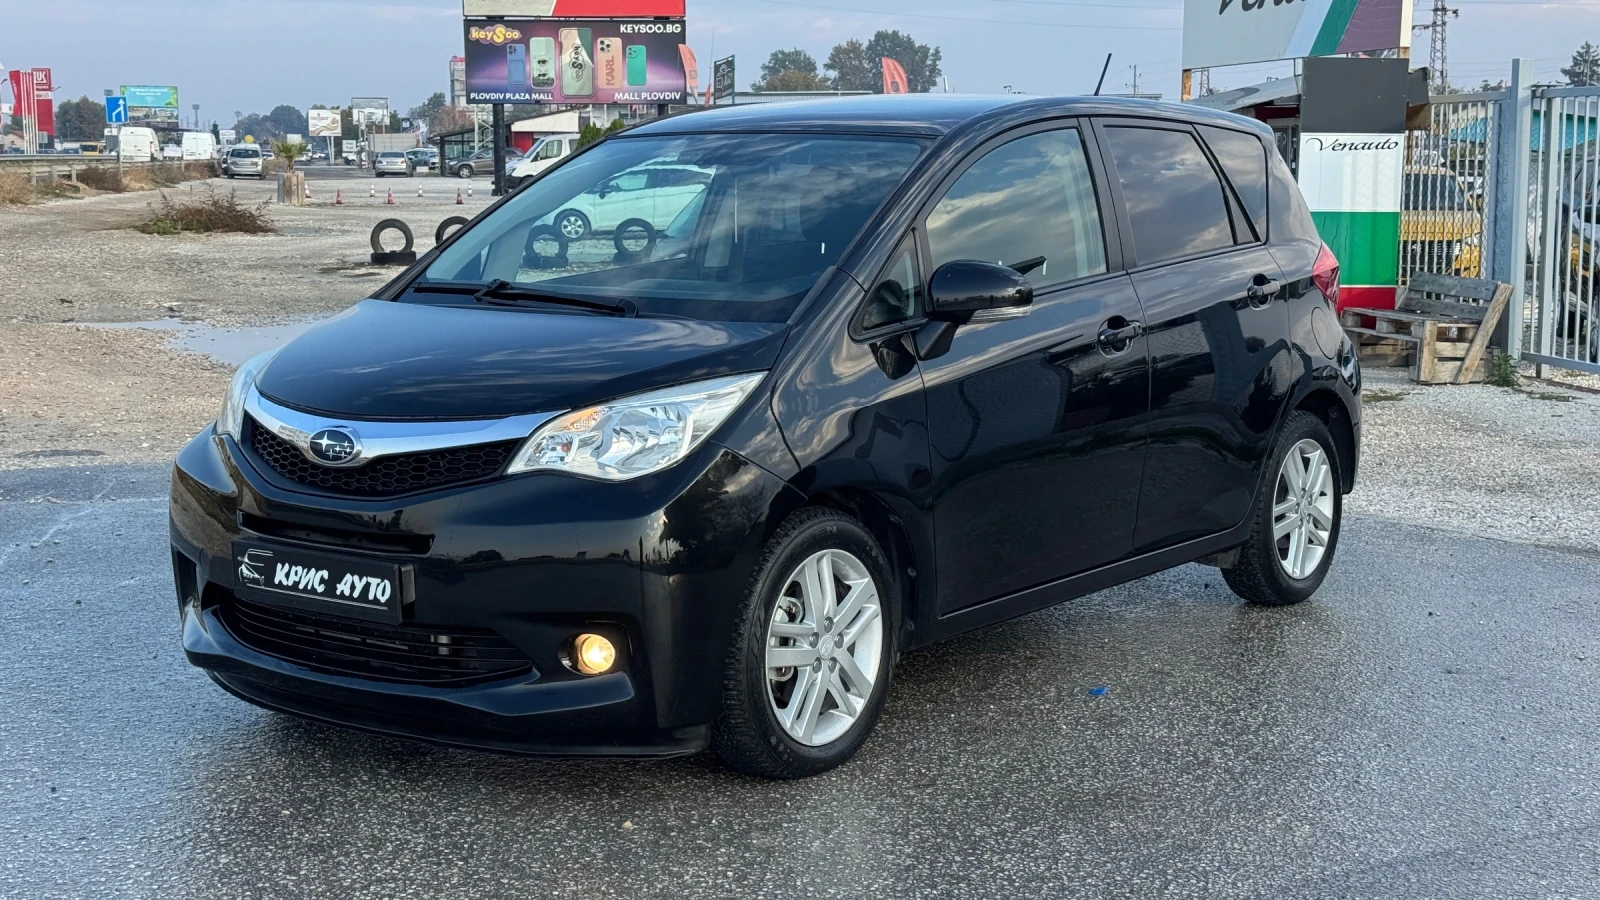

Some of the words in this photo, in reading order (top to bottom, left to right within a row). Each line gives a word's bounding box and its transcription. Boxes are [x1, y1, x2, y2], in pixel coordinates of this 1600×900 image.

[471, 26, 520, 43] keySoo
[620, 24, 682, 33] KEYSOO.BG
[605, 55, 615, 86] KARL
[470, 92, 504, 100] PLOVDIV
[505, 92, 530, 100] PLAZA
[614, 92, 640, 100] MALL
[641, 92, 681, 100] PLOVDIV
[1305, 137, 1399, 152] Venauto
[274, 562, 329, 593] КРИС
[335, 573, 392, 603] АУТО
